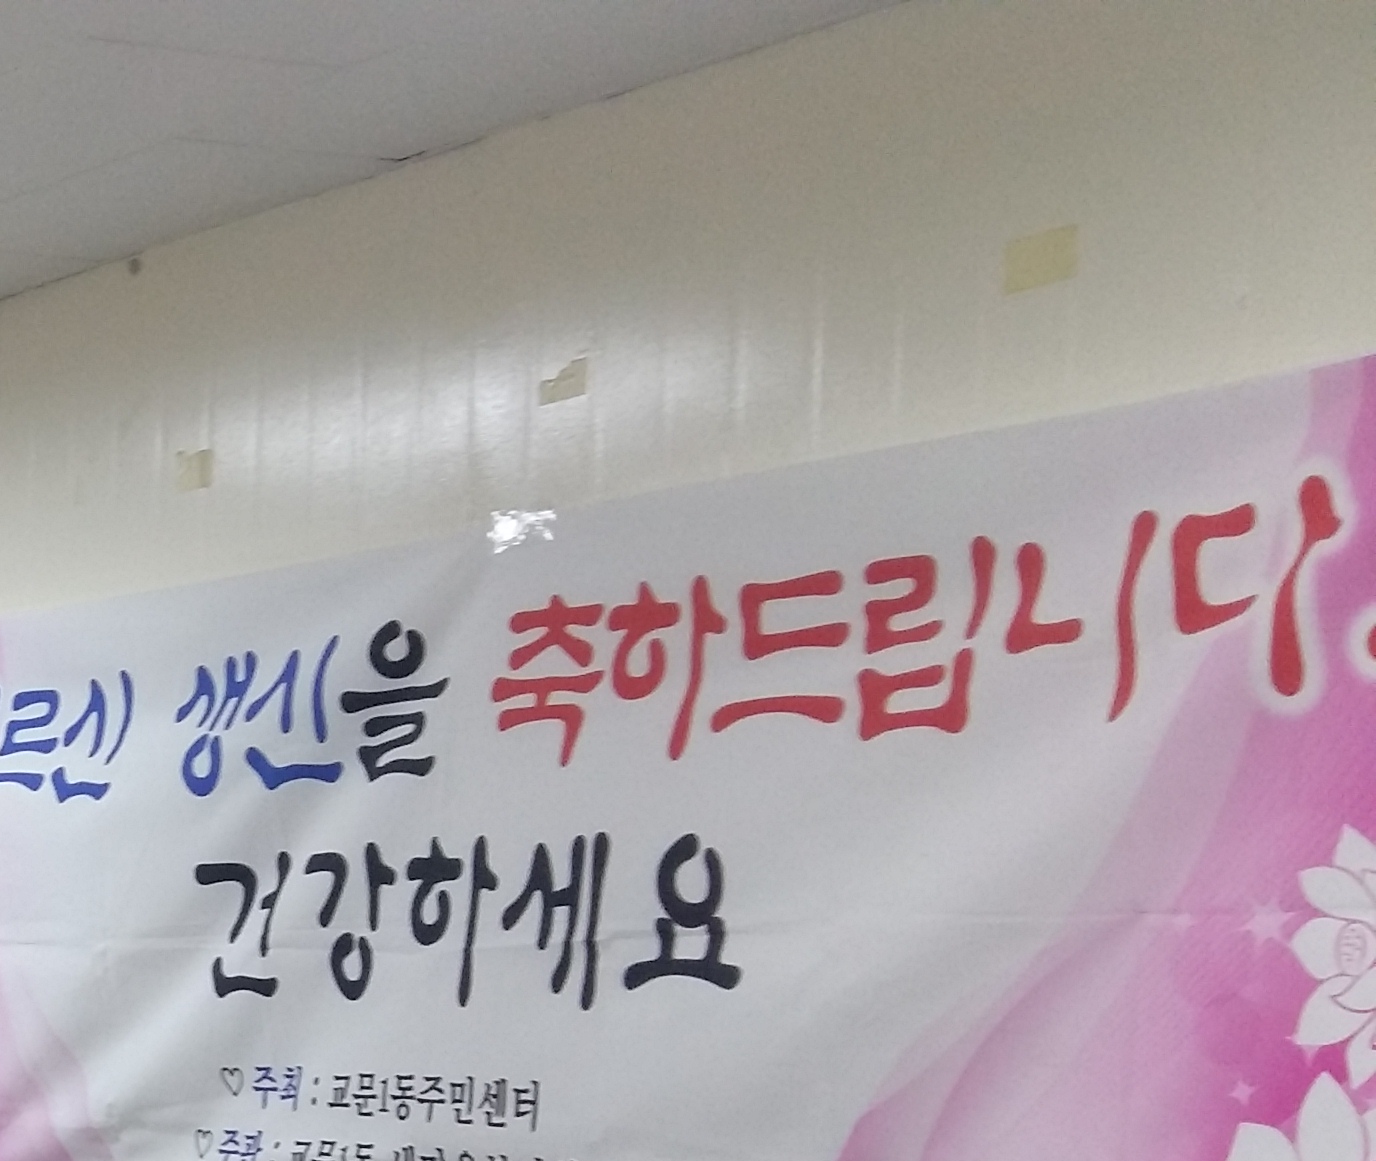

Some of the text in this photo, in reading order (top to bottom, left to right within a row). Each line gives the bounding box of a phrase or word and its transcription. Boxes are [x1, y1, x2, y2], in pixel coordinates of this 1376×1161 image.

[176, 620, 449, 797] 생신을
[491, 474, 1376, 768] 축하드립니다
[195, 832, 742, 1010] 건강하세요
[252, 1065, 304, 1111] 주최
[327, 1073, 540, 1132] 교문1동주민센터
